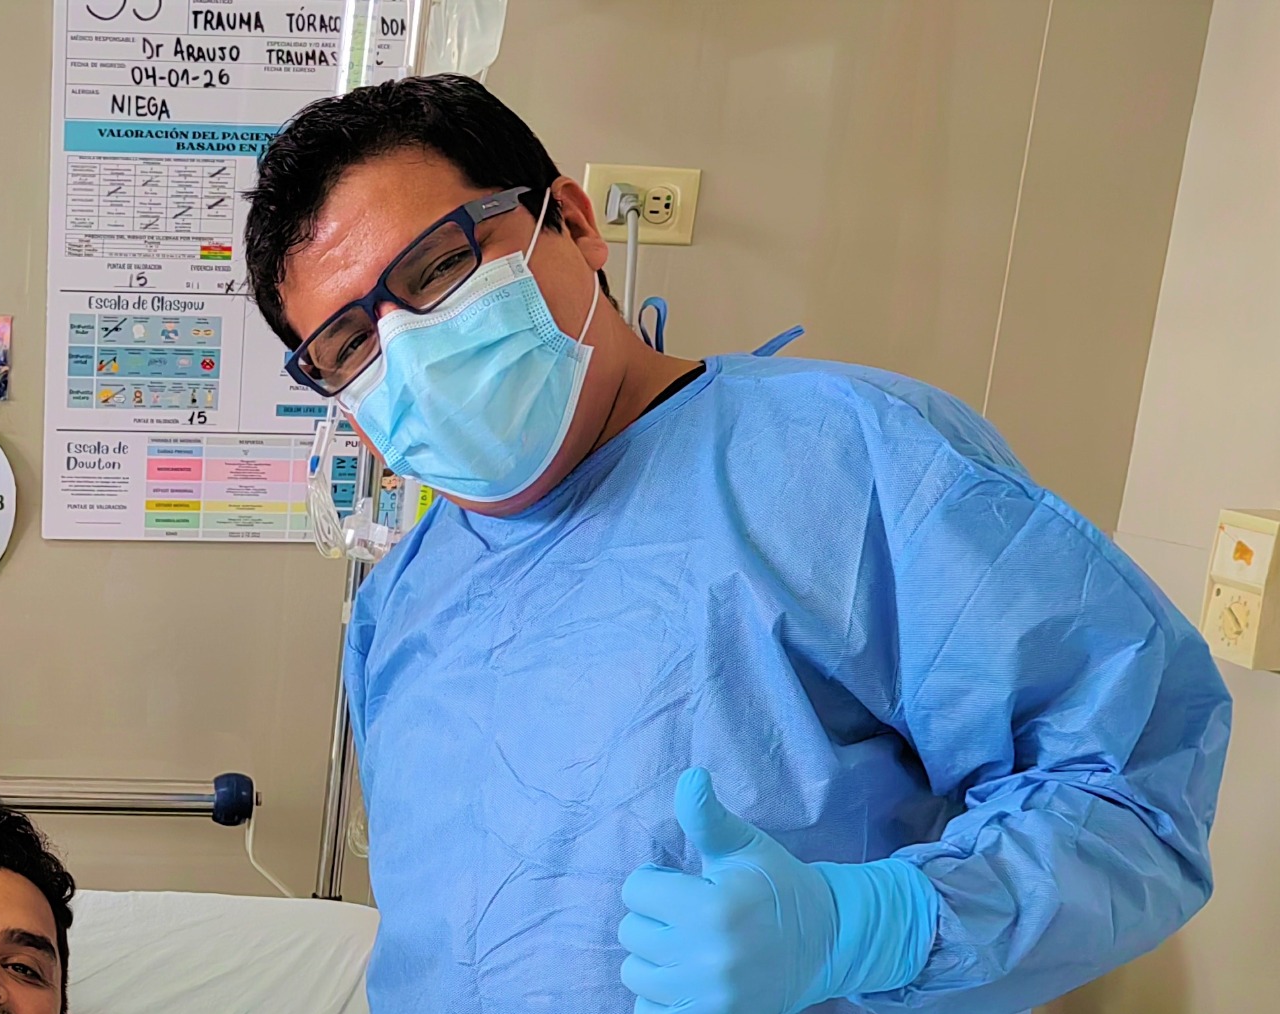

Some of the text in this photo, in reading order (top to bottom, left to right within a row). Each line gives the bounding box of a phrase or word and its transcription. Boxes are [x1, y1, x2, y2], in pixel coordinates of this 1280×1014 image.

[192, 9, 265, 33] TRAUMA
[142, 37, 241, 62] Dr ARAUJO
[131, 66, 231, 88] 04-01-26
[111, 94, 170, 121] NIEGA
[98, 127, 189, 140] VALORACIÓN
[192, 131, 219, 140] DEL
[176, 142, 236, 152] BASADO
[239, 143, 257, 152] EN
[129, 272, 148, 287] 15
[88, 295, 205, 313] Escala de Glasgow
[188, 411, 208, 425] 15
[67, 441, 129, 455] Escala de
[66, 456, 122, 471] Dowton
